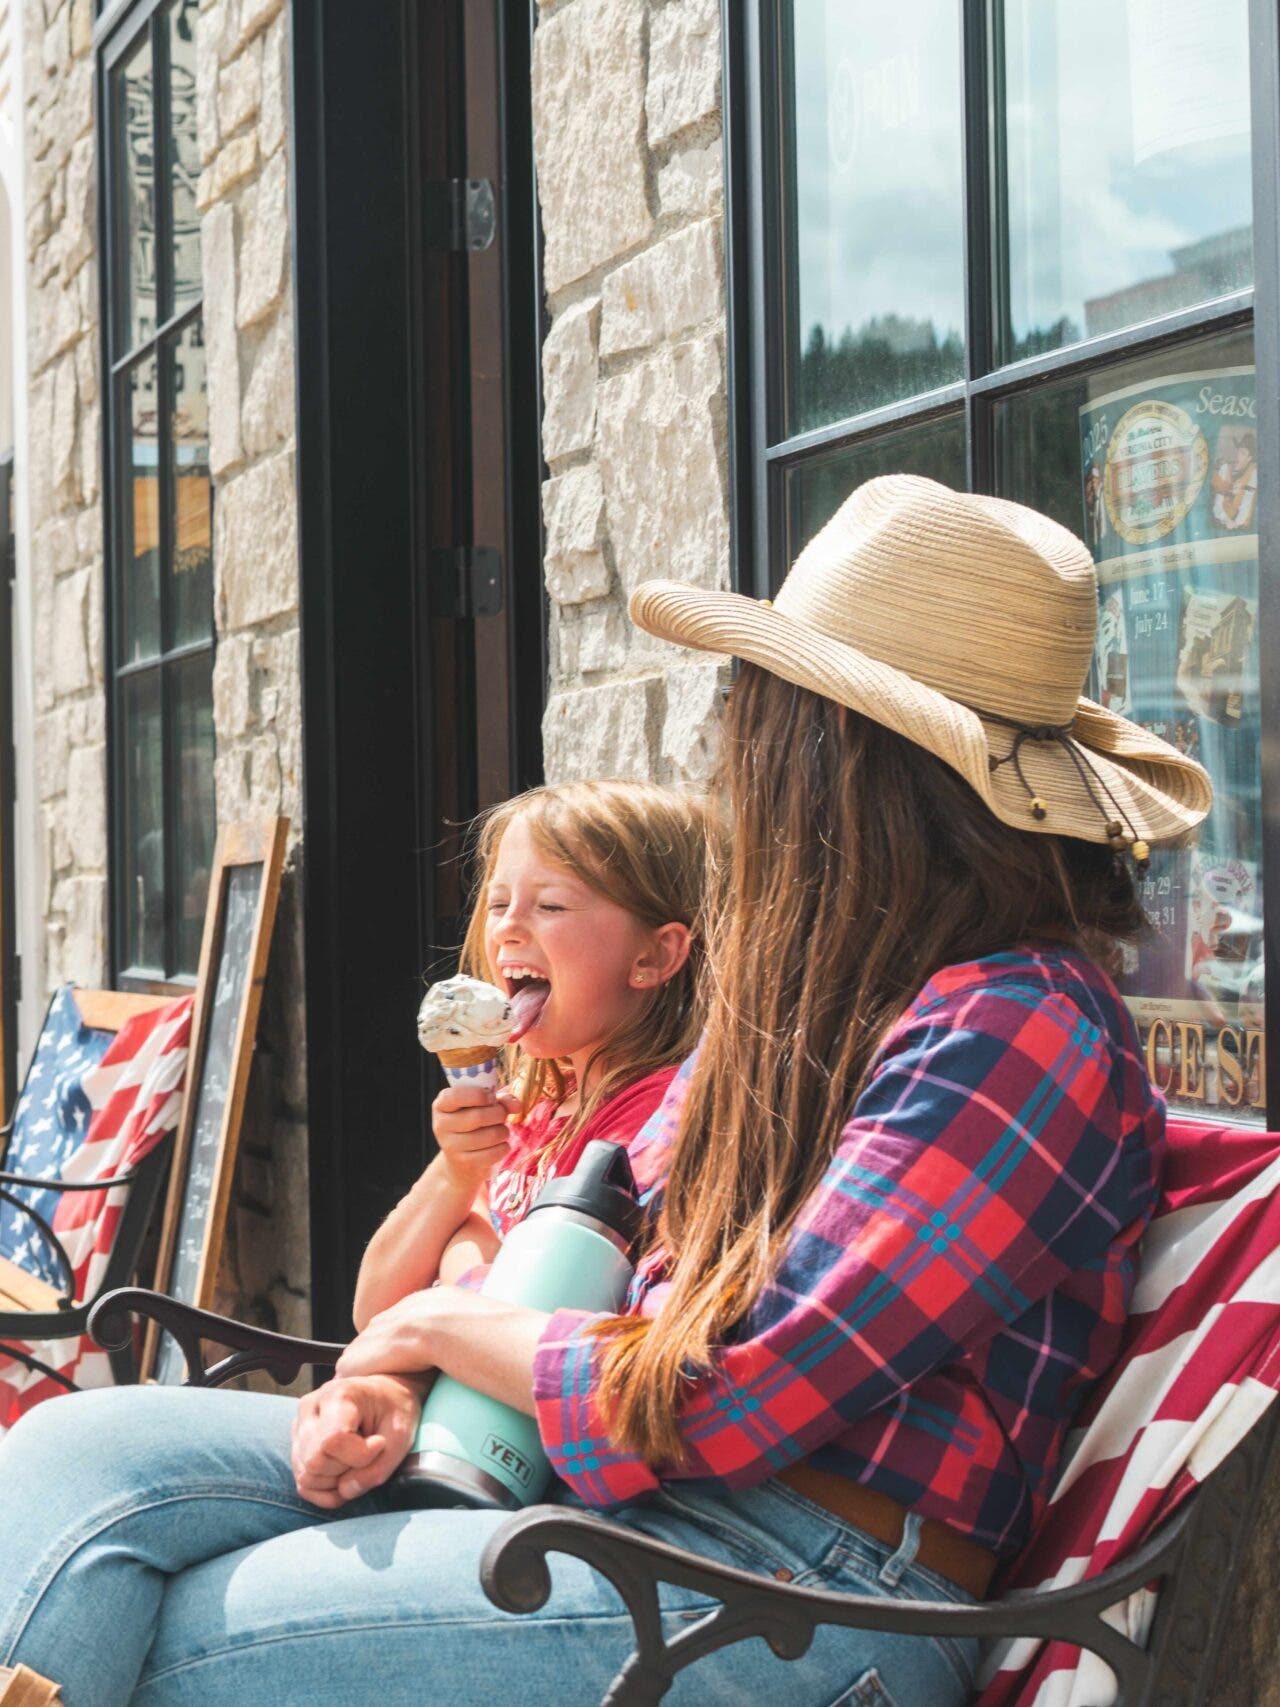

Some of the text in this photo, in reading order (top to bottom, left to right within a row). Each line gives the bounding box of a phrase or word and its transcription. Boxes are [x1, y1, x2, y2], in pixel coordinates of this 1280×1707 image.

[1152, 581, 1165, 601] 17
[1154, 611, 1168, 631] 24
[1157, 876, 1170, 895] 29
[1162, 906, 1176, 925] 31
[1145, 1017, 1206, 1099] CE
[490, 1439, 531, 1481] YETI
